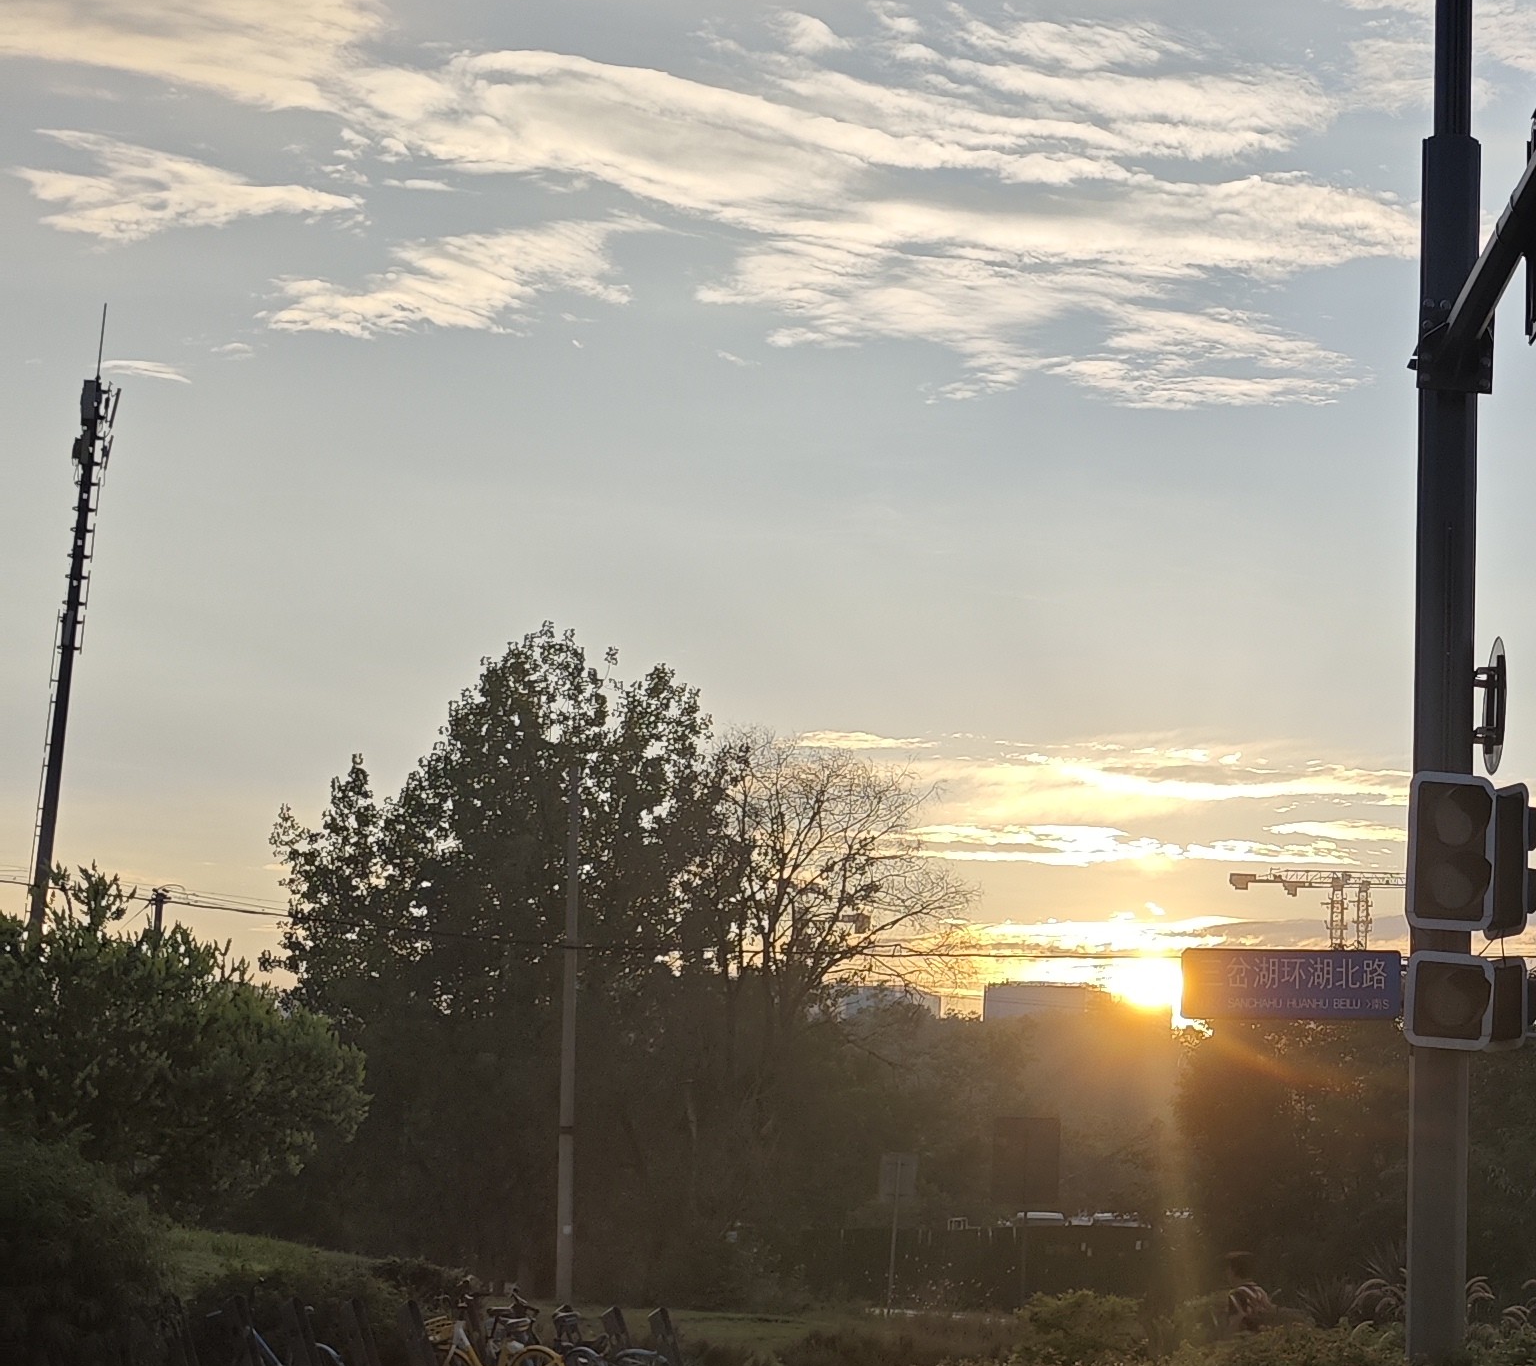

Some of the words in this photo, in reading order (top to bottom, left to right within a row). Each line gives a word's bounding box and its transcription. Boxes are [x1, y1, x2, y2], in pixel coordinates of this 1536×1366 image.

[1199, 957, 1388, 990] 三岔湖环湖北路
[1227, 997, 1282, 1010] SANCHAHU
[1287, 997, 1329, 1010] HUANHU
[1333, 998, 1361, 1010] BEILU
